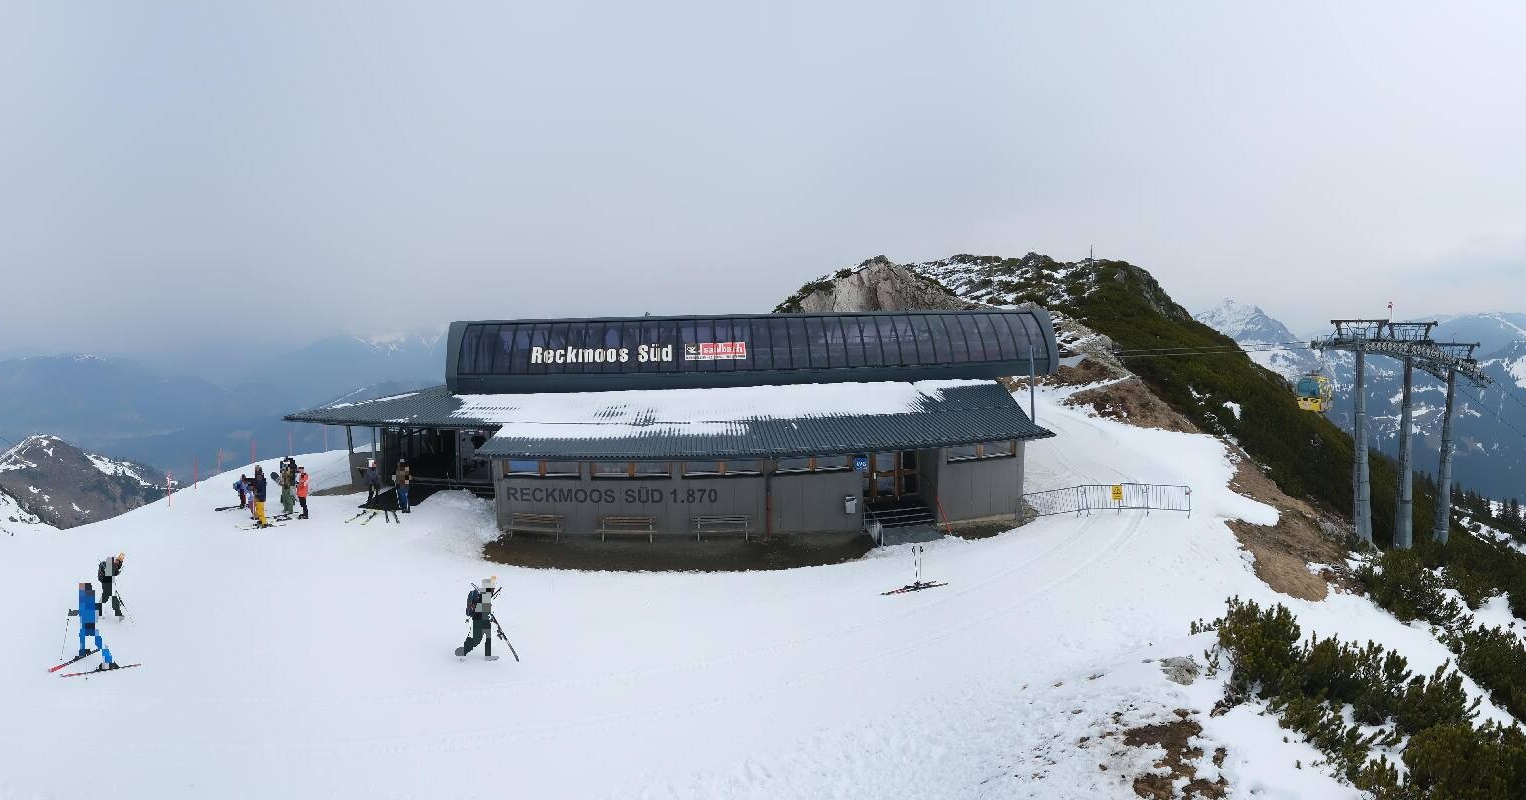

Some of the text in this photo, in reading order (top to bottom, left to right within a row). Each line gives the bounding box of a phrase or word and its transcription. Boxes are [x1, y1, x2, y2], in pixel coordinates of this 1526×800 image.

[530, 344, 673, 364] Reckmoos Süd
[506, 486, 718, 504] RECKMOOS SÜD 1.870
